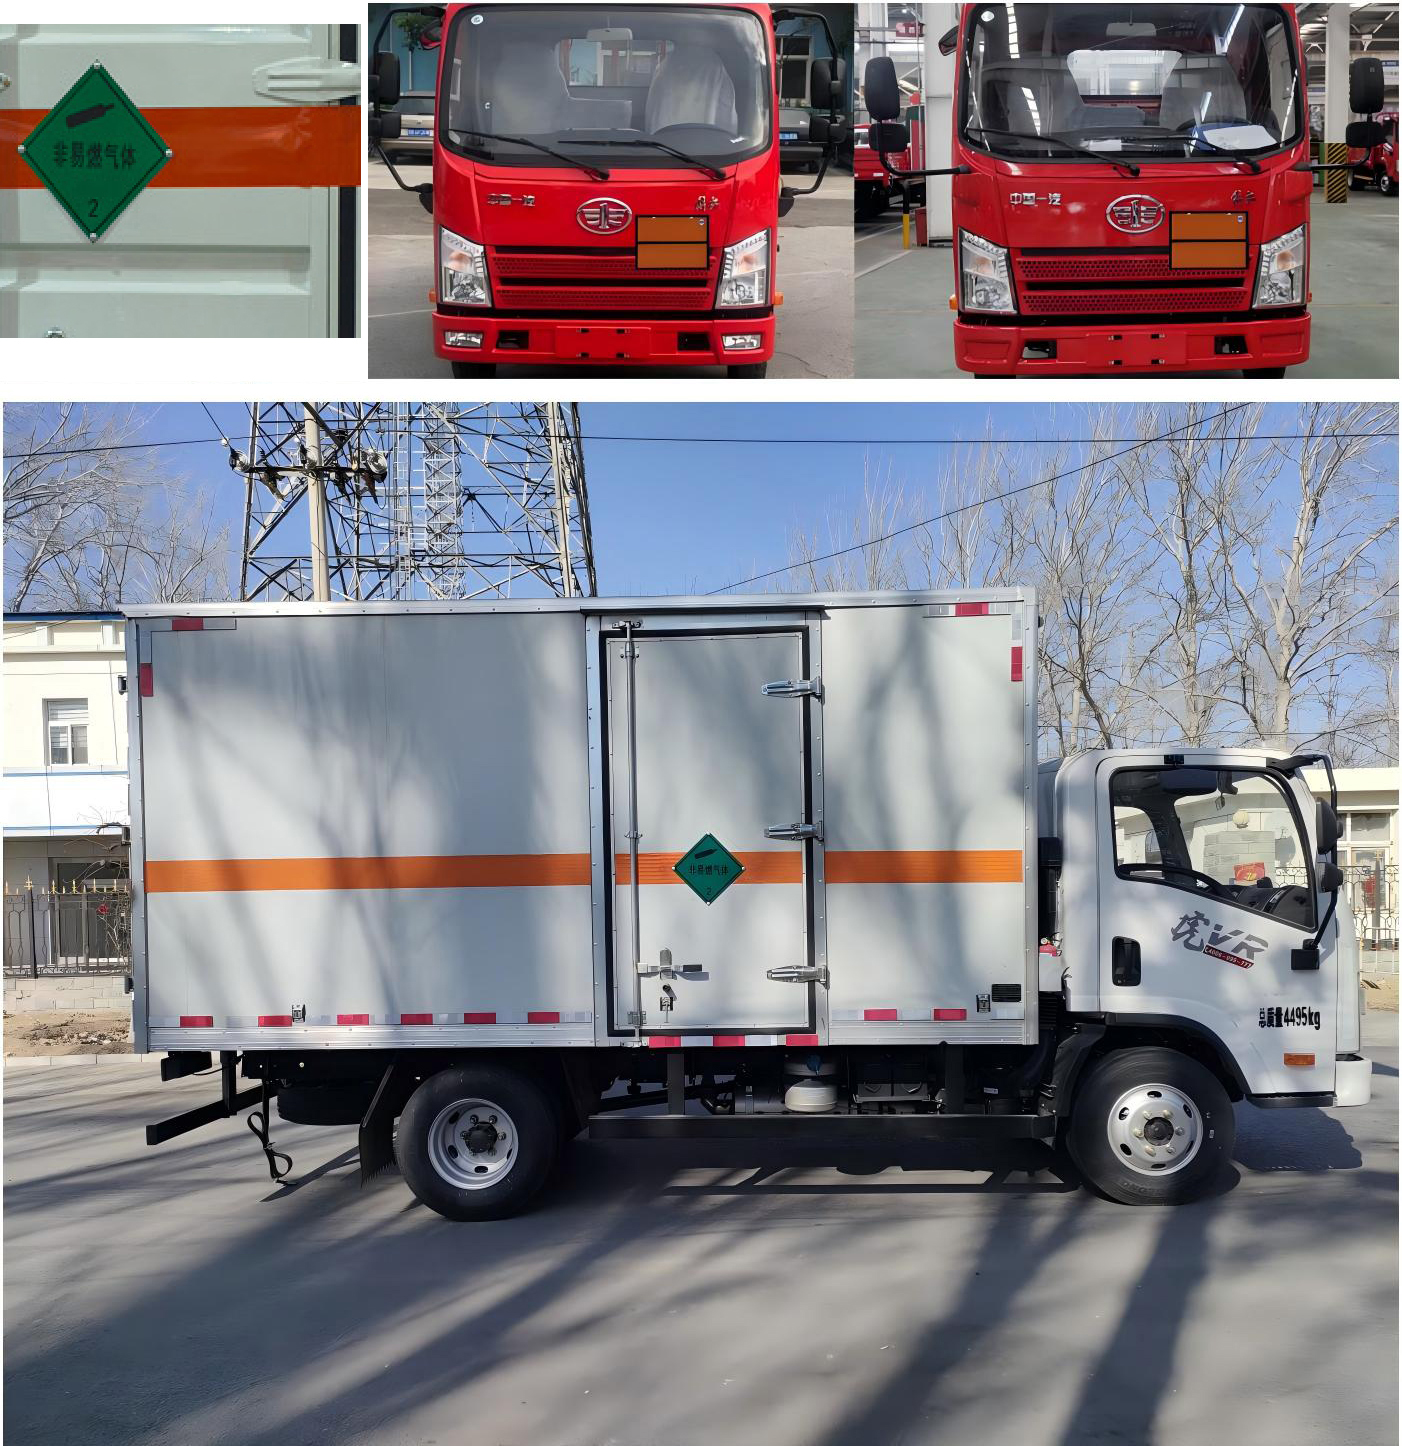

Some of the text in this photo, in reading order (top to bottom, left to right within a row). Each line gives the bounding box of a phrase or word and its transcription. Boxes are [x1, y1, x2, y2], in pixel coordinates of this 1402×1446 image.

[53, 140, 137, 170] 非易燃气体
[88, 198, 99, 218] 2
[1009, 192, 1062, 206] 中国一汽
[706, 887, 712, 896] 2
[1258, 1006, 1321, 1031] 总质量4495kg
